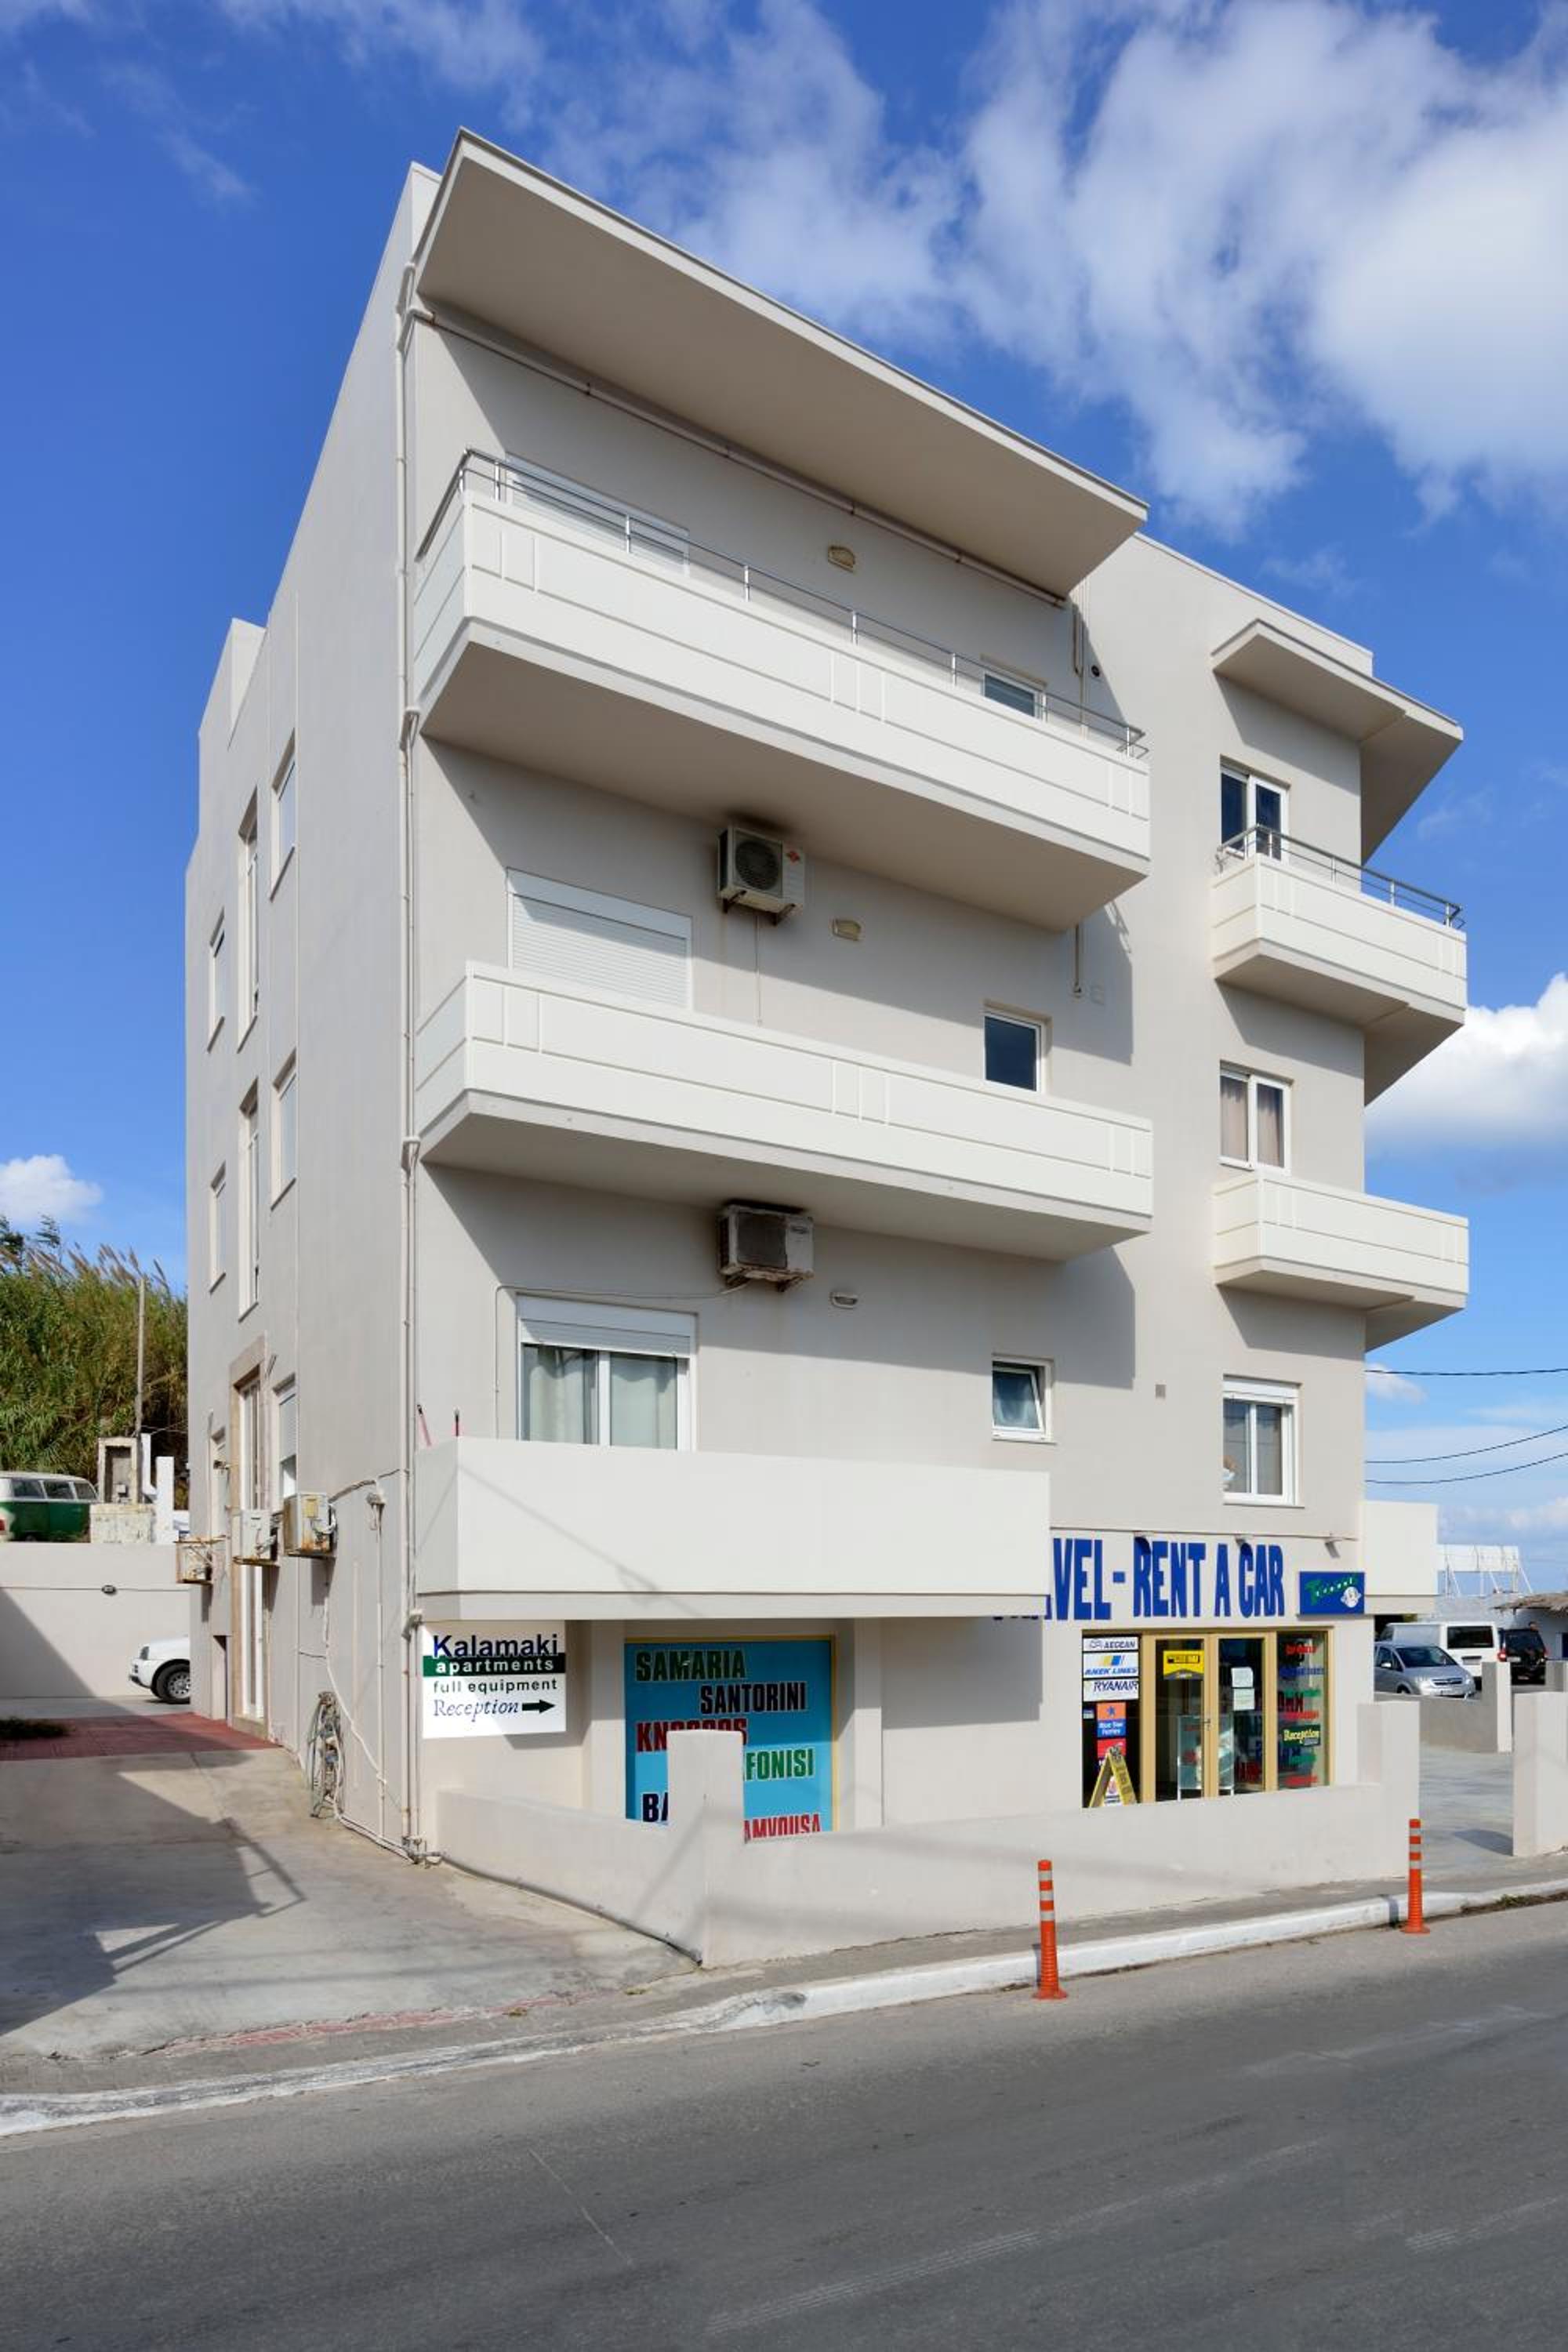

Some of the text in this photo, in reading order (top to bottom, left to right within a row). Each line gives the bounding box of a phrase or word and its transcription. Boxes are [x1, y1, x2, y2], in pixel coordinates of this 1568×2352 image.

[1134, 1537, 1207, 1618] RENT
[1214, 1543, 1231, 1617] A
[1239, 1542, 1285, 1618] CAR
[433, 1633, 557, 1659] Kalamaki
[435, 1657, 554, 1675] apartments
[636, 1650, 746, 1682] SAMARIA
[433, 1678, 557, 1694] full equipment
[700, 1682, 807, 1715] SANTORINI
[1094, 1679, 1138, 1693] RYANAIR
[434, 1699, 520, 1722] Reception
[743, 1748, 814, 1780] FONISI
